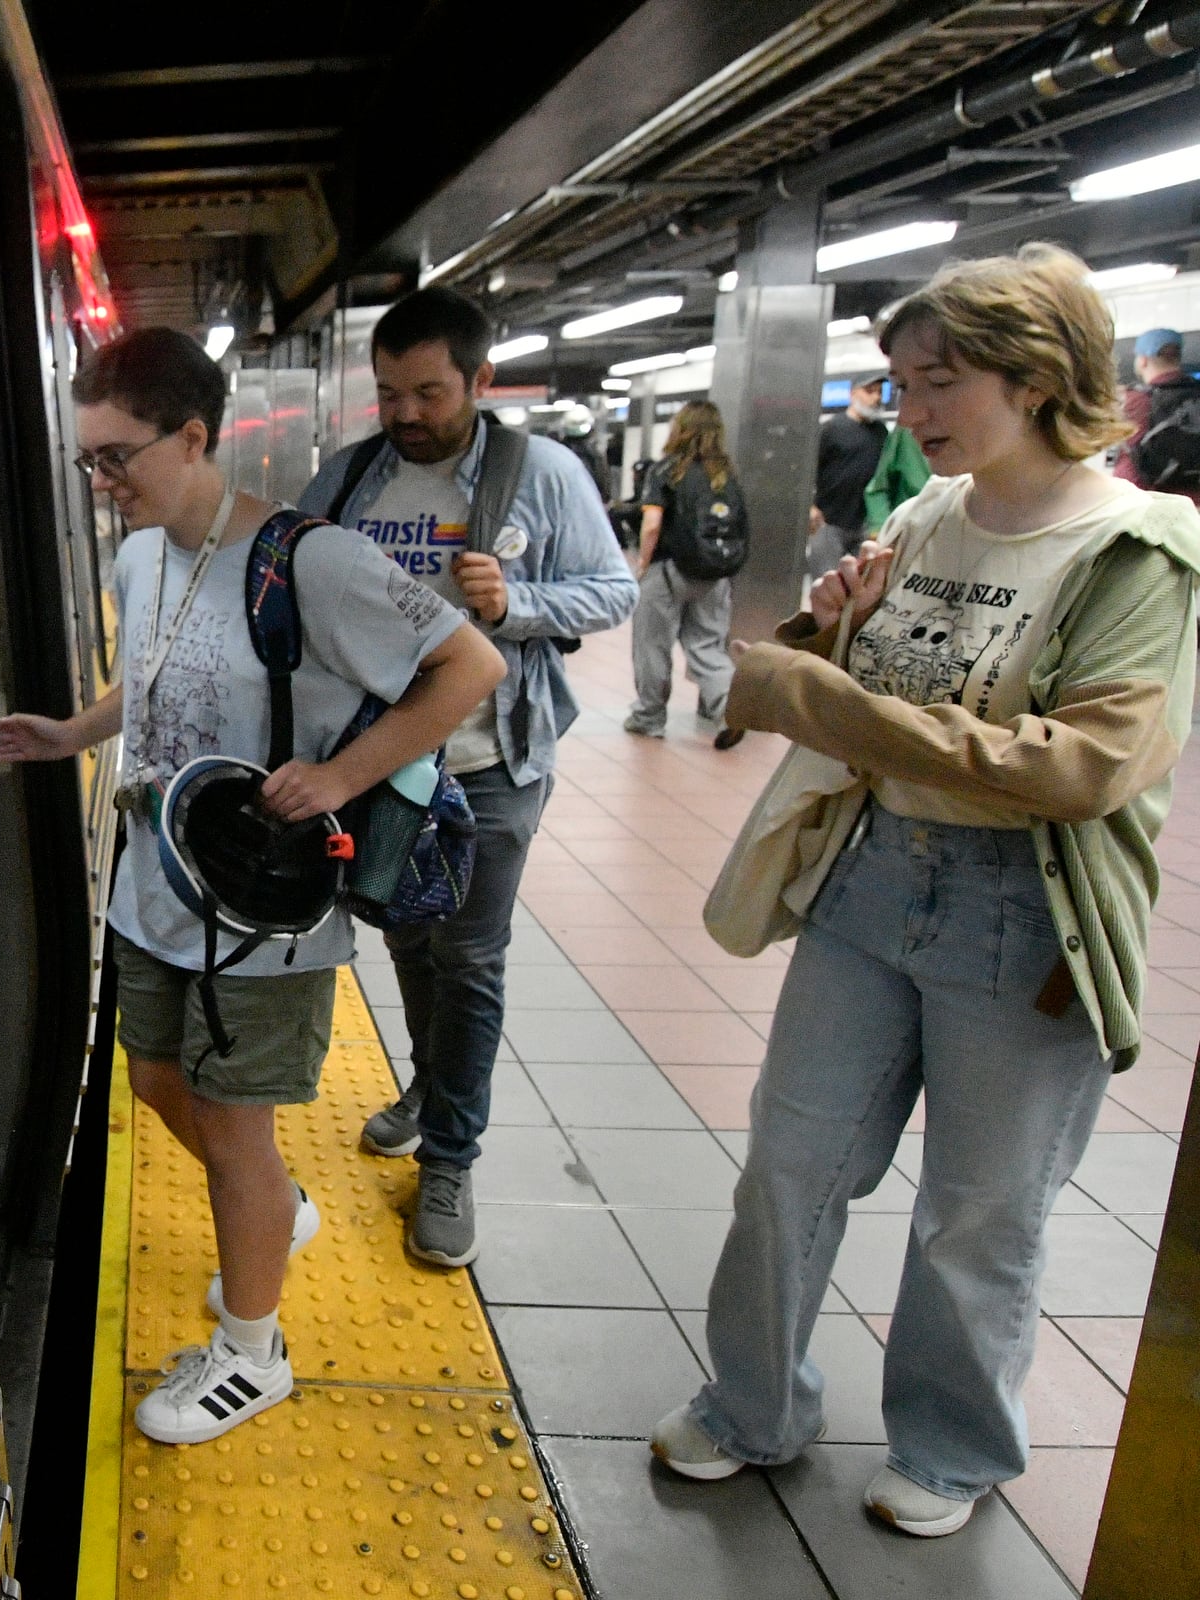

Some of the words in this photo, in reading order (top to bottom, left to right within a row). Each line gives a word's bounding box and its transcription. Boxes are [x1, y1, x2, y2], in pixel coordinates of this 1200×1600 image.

[356, 513, 466, 545] ransit
[393, 551, 442, 575] ves
[966, 583, 1017, 608] ISLES
